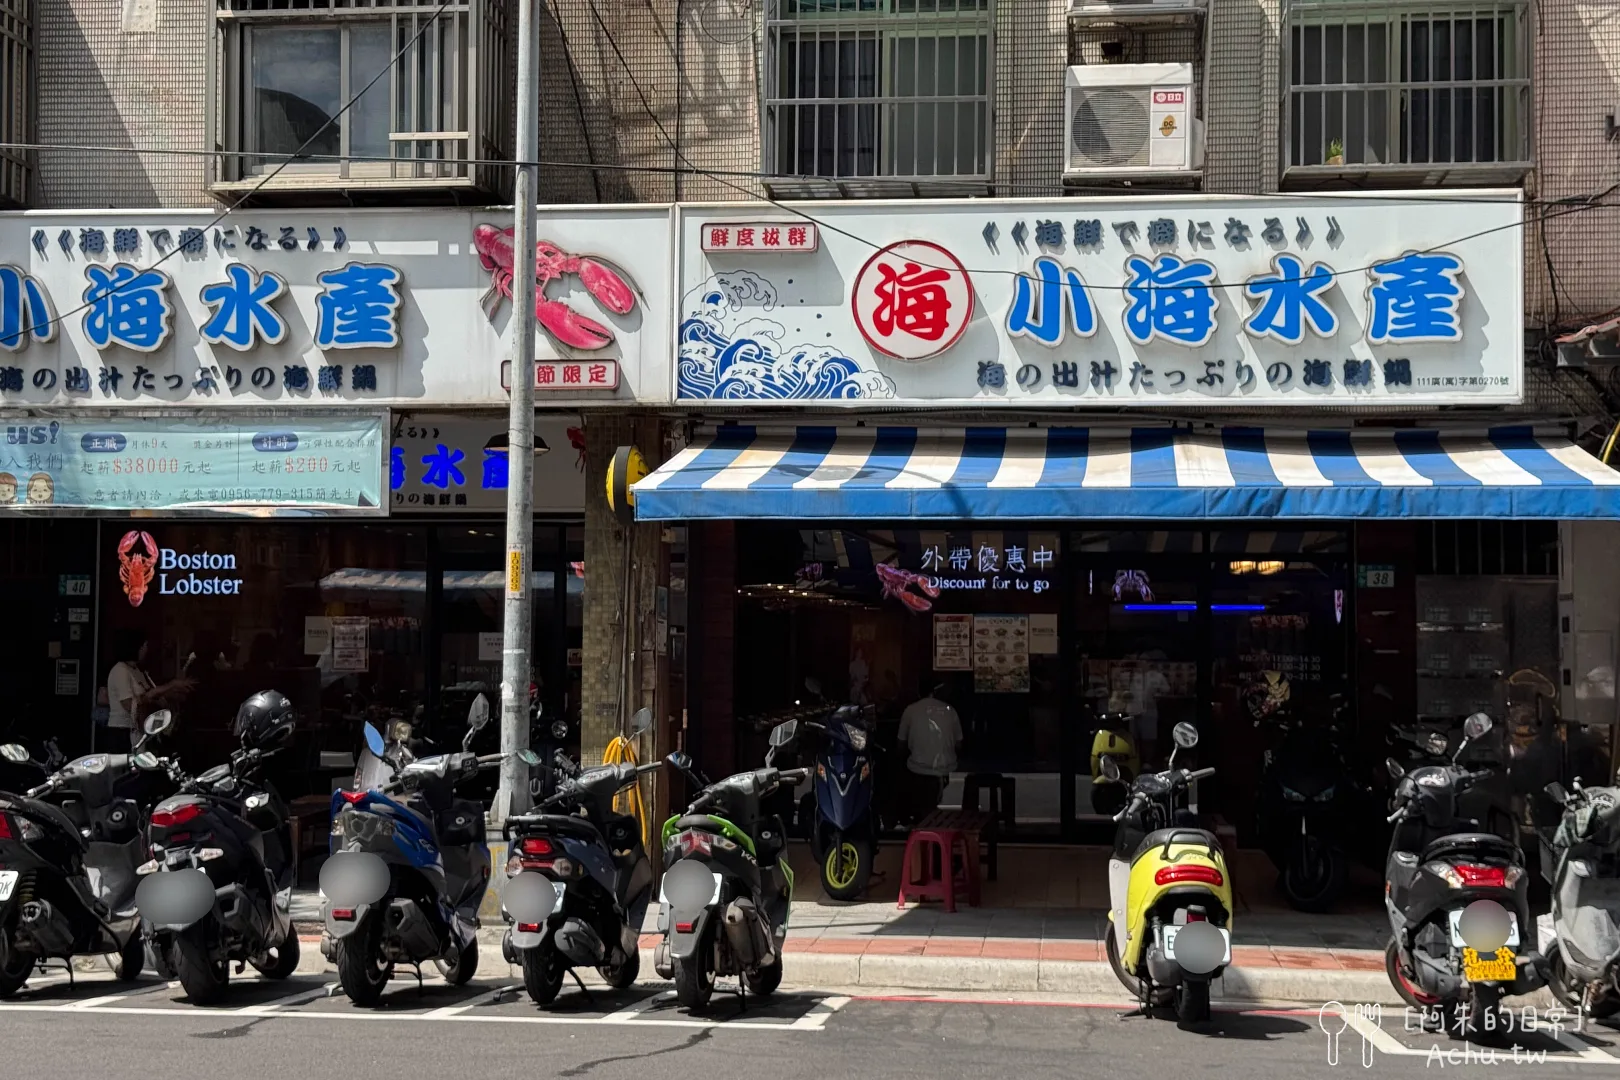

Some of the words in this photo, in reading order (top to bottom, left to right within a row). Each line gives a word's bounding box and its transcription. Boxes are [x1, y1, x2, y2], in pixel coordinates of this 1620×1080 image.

[872, 261, 953, 341] 海
[1008, 253, 1463, 344] 小海水產
[536, 363, 607, 385] 節限定
[7, 420, 61, 446] us!
[90, 437, 118, 450] 正職
[261, 436, 289, 450] 計時
[160, 548, 237, 571] Boston
[920, 544, 1053, 574] 外帶優惠中
[72, 581, 86, 593] 40
[160, 573, 243, 595] Lobster
[927, 576, 987, 590] Discount
[992, 575, 1011, 590] for
[1015, 577, 1029, 590] to
[1033, 578, 1050, 594] go
[1373, 571, 1389, 585] 38
